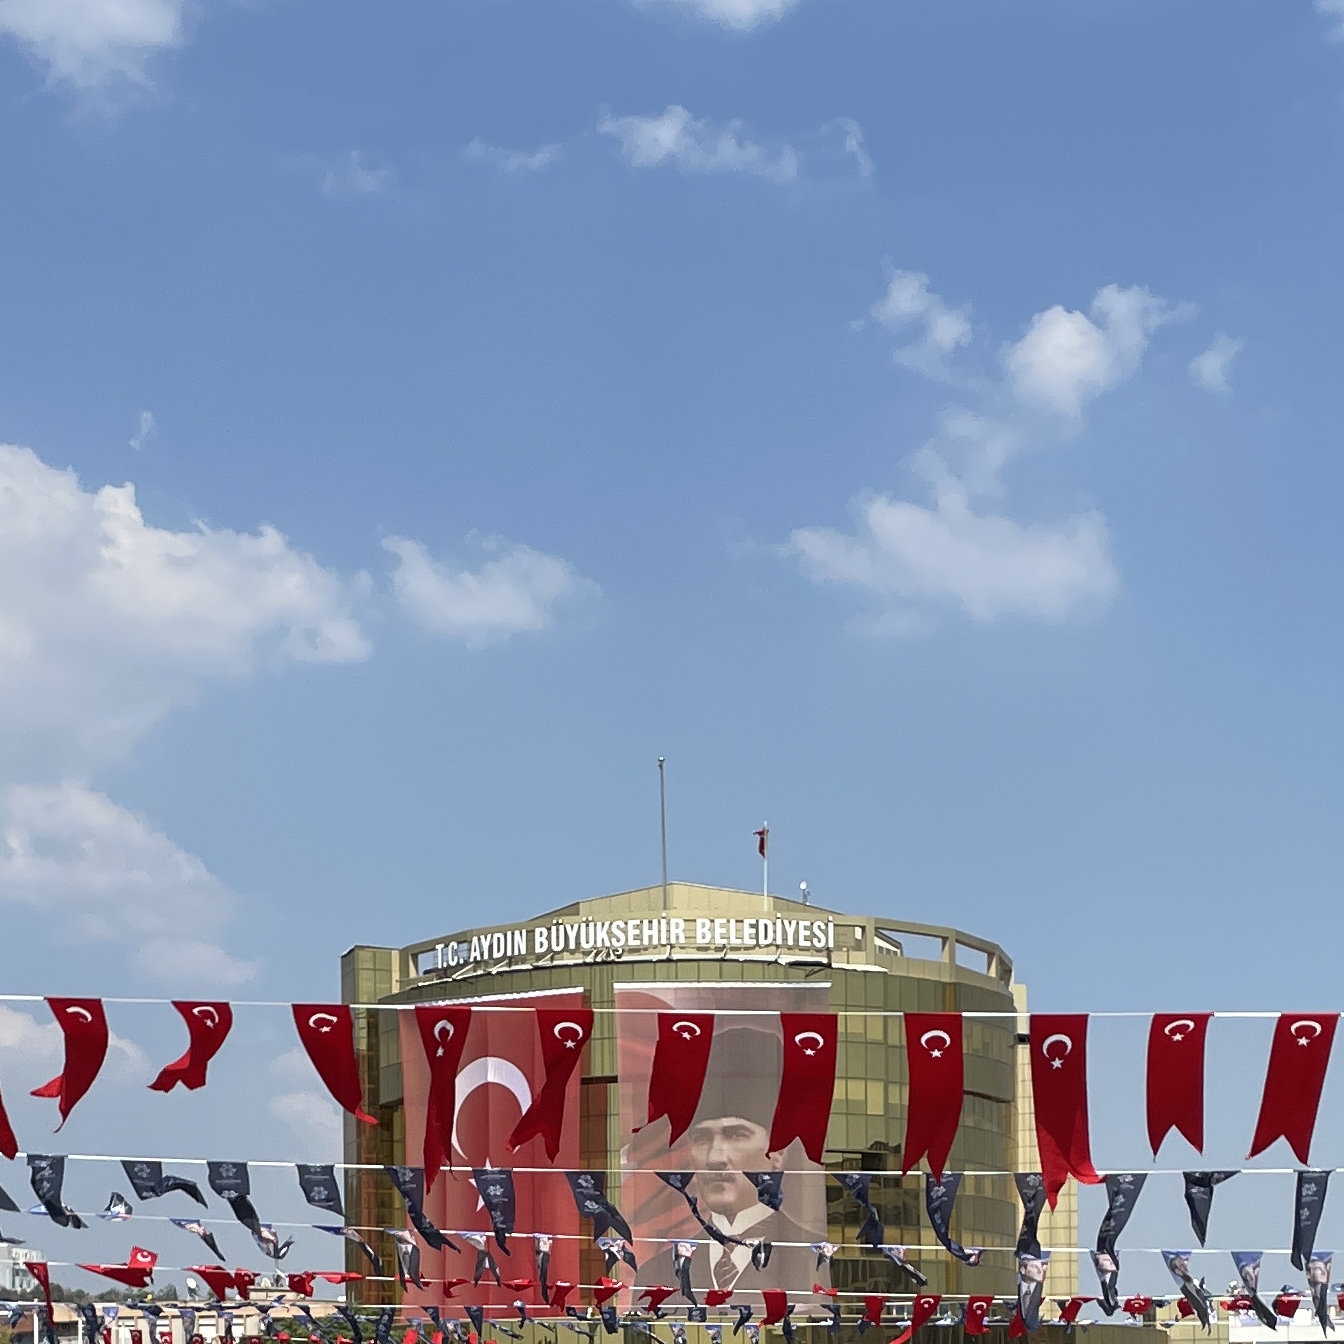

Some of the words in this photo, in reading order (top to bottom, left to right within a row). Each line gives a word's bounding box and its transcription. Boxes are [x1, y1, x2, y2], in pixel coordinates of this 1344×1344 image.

[435, 943, 464, 969] T.C.
[470, 928, 527, 962] AYDIN
[534, 912, 686, 955] BÜYÜKŞEHİR
[695, 912, 835, 948] BELEDİYESİ
